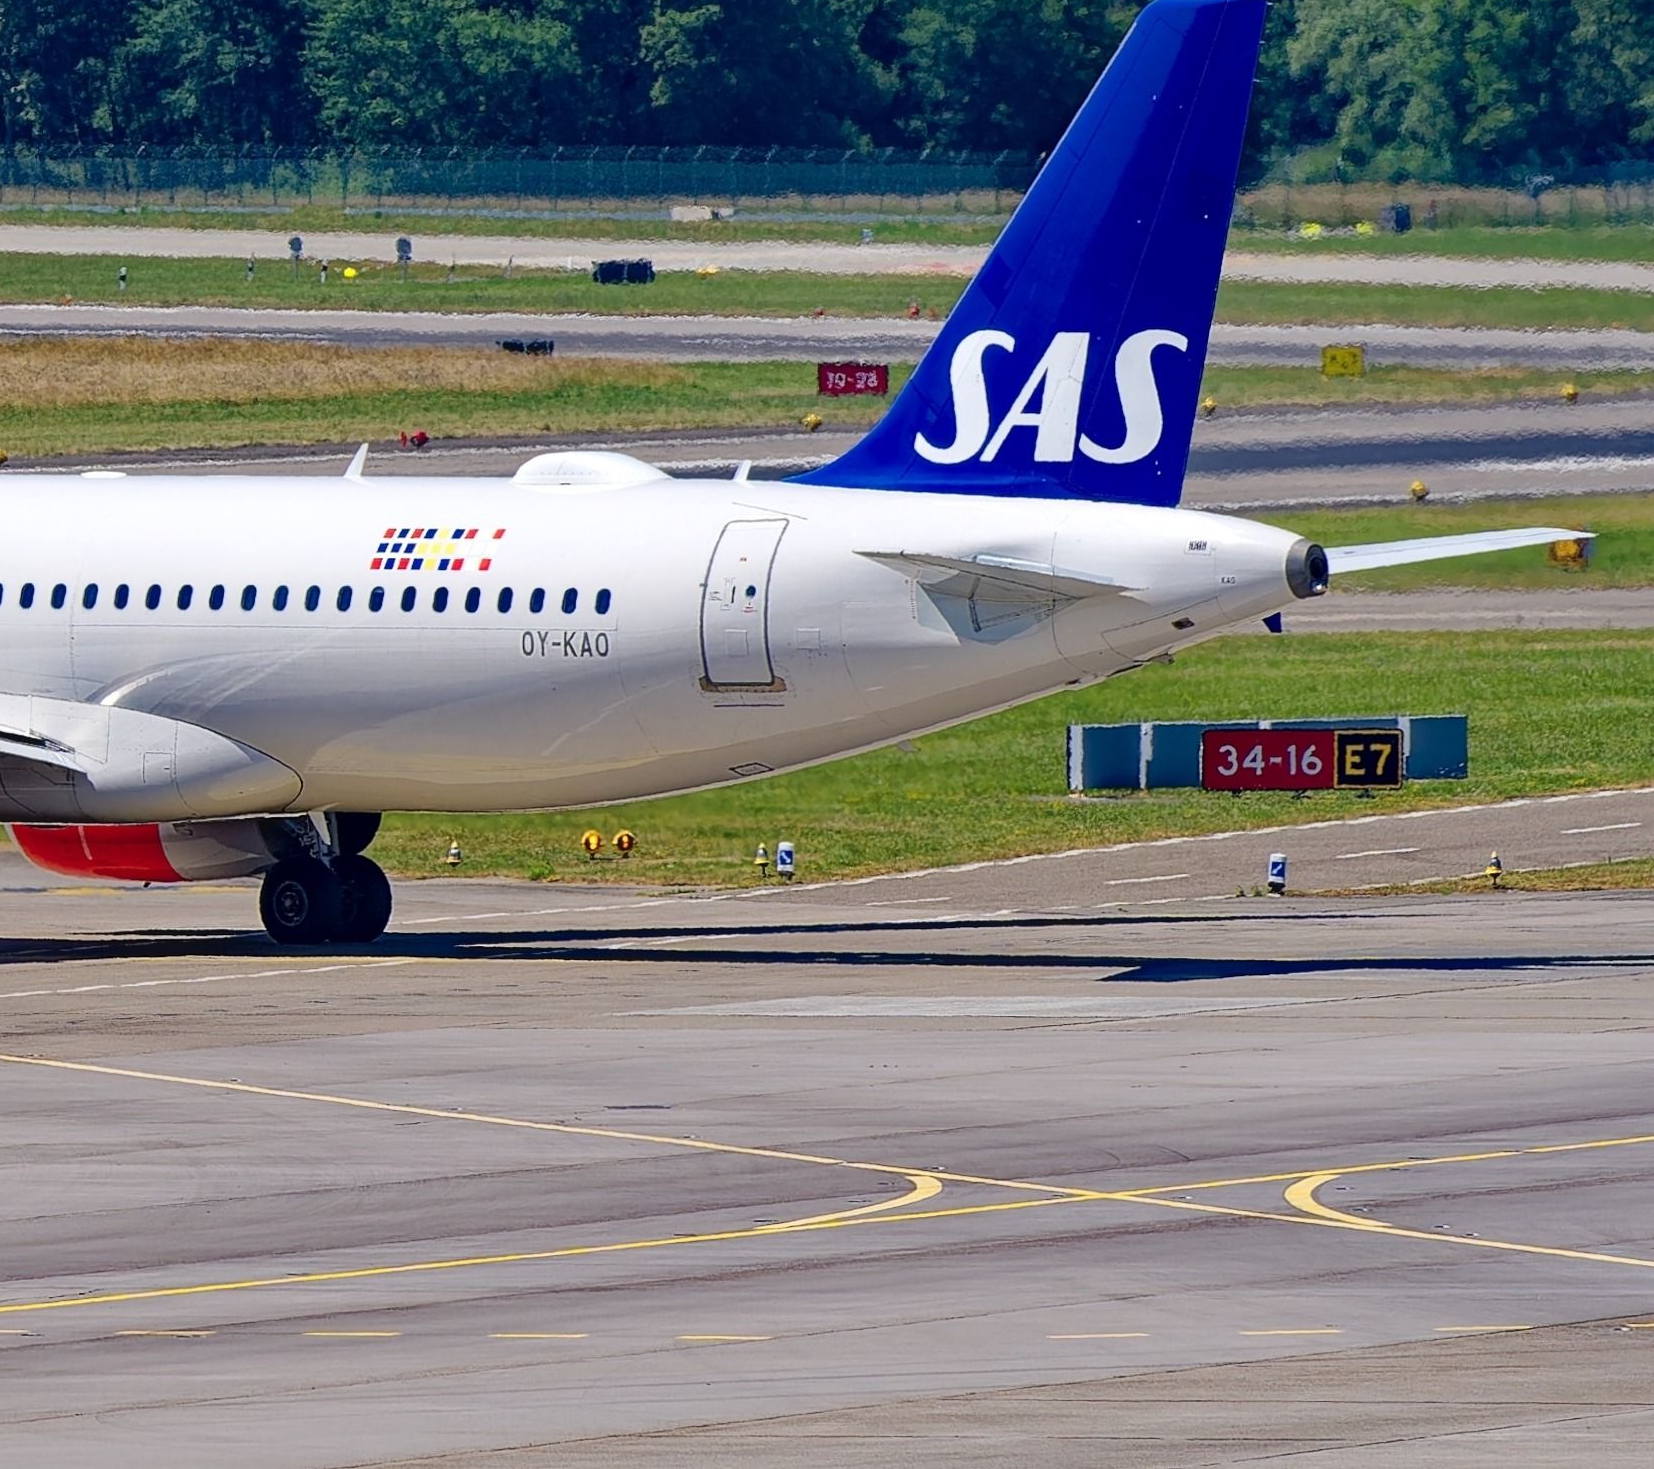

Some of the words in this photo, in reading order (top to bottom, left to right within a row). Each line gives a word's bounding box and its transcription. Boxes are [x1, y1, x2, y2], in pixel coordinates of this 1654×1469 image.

[914, 329, 1188, 464] SAS
[522, 631, 609, 657] OY-KAO
[1217, 744, 1322, 776] 34-16
[1345, 743, 1392, 776] E7
